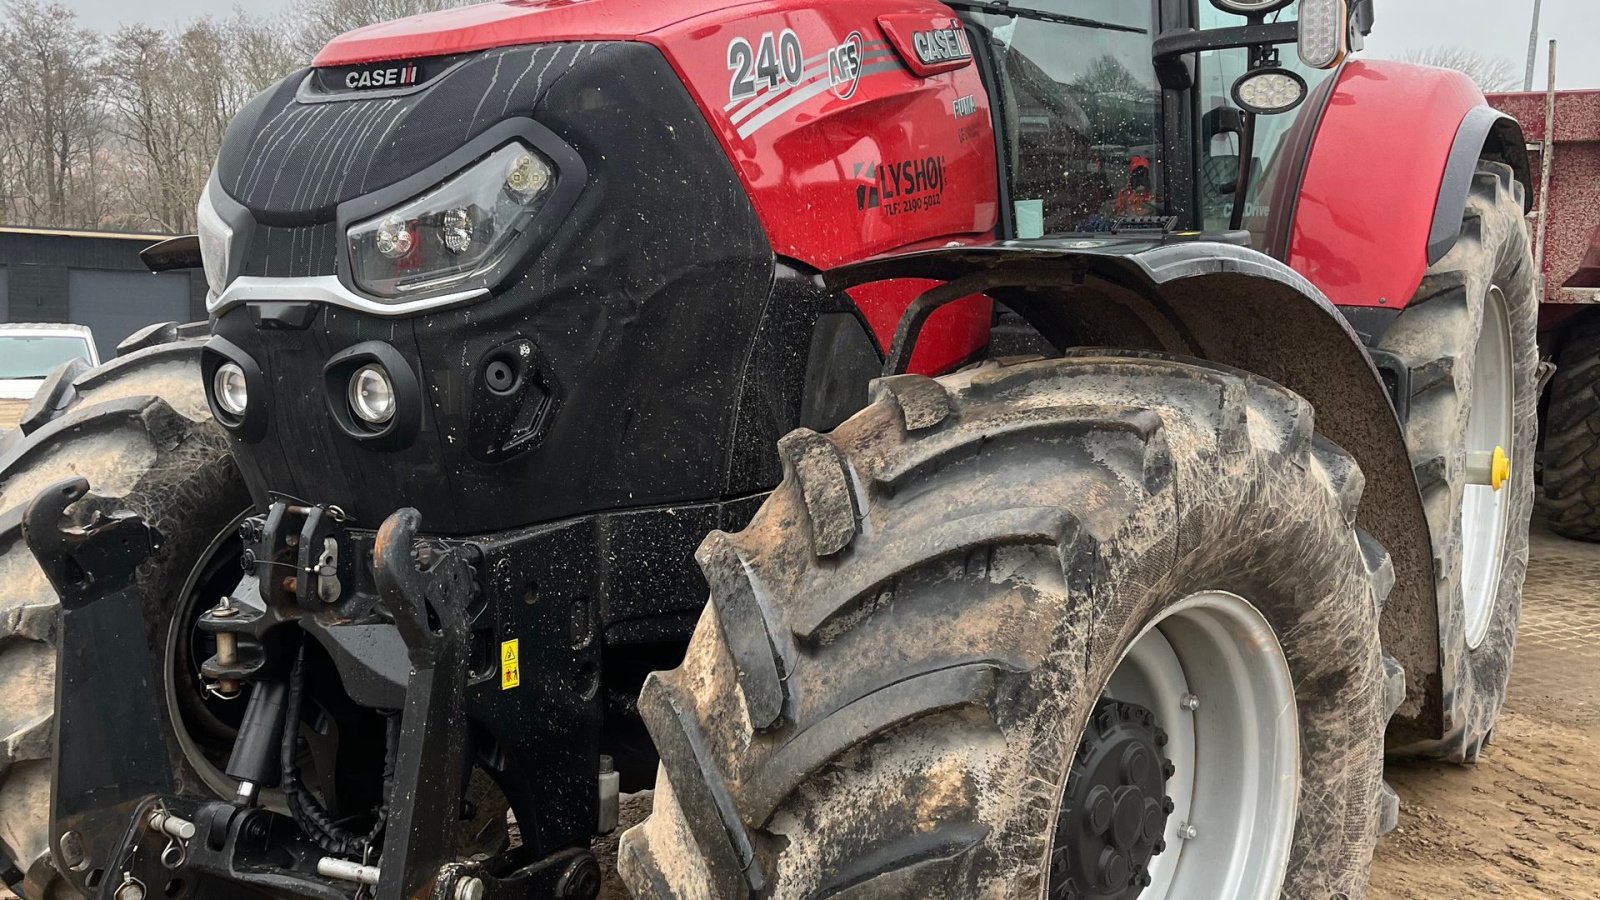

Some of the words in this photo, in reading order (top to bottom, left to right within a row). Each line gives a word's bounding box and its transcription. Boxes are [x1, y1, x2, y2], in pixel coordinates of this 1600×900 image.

[913, 29, 960, 62] CASE
[345, 68, 398, 88] CASE
[727, 28, 803, 101] 240
[828, 41, 859, 87] AFS
[879, 156, 943, 199] LYSHØJ
[903, 199, 921, 213] 2190
[923, 193, 940, 211] 5012
[1223, 202, 1270, 218] CDrive
